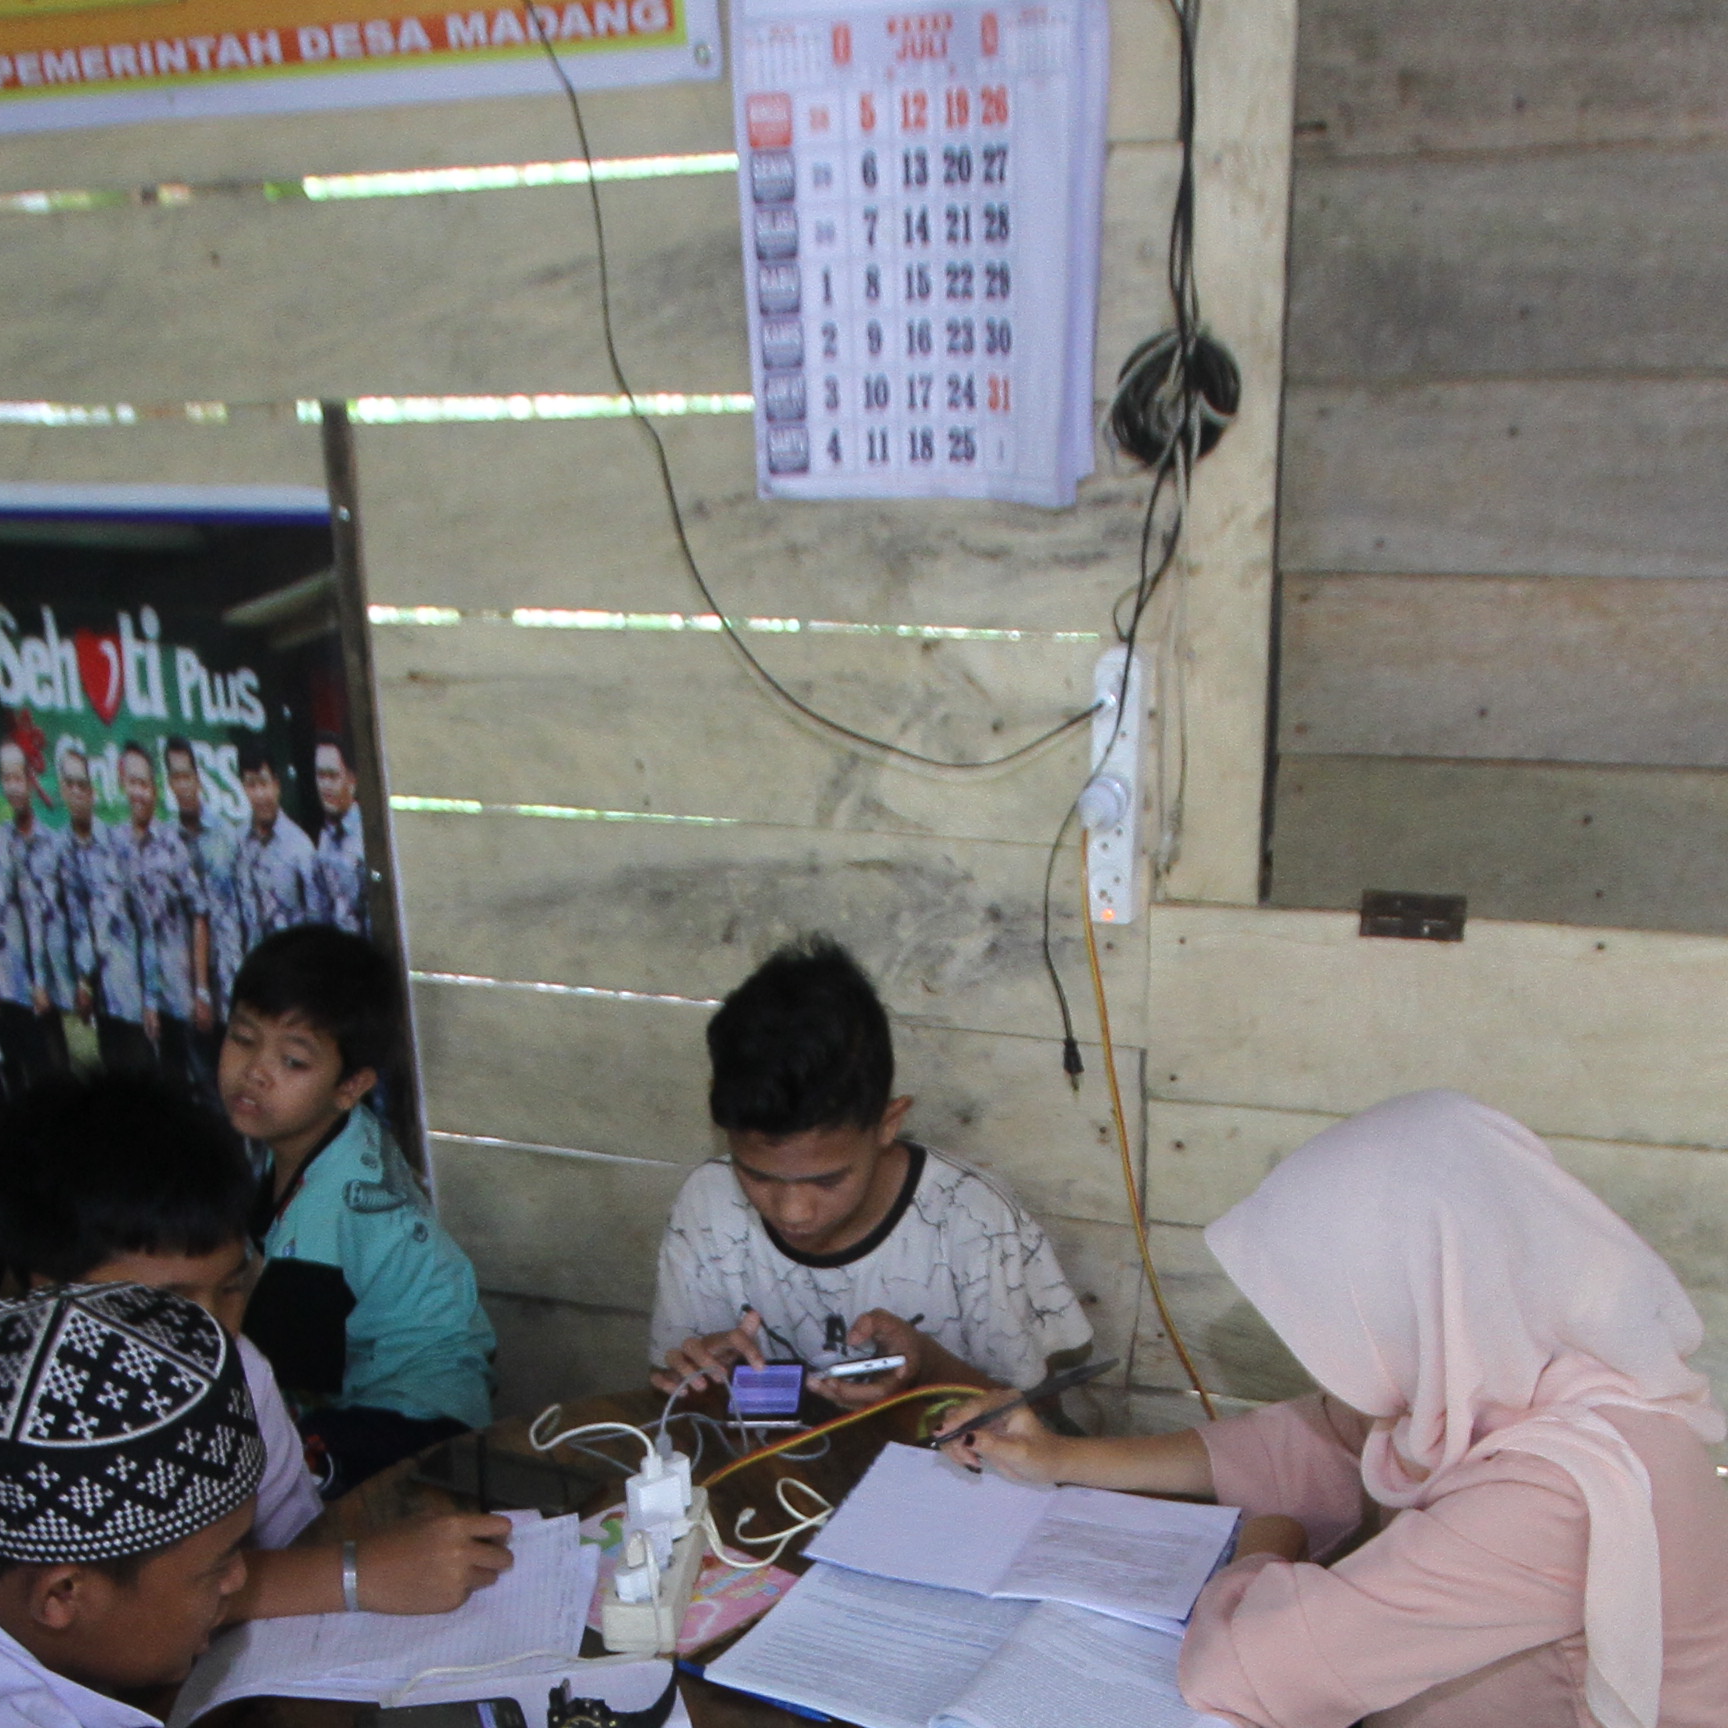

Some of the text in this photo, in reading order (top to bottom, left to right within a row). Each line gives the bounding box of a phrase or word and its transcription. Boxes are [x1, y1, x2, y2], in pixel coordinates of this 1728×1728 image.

[296, 16, 434, 62] DESA
[442, 0, 670, 52] MADANG
[901, 90, 928, 132] 12
[980, 87, 1009, 126] 26
[861, 153, 878, 190] 6
[902, 150, 929, 190] 13
[942, 149, 973, 187] 20
[982, 146, 1008, 185] 27
[863, 209, 878, 248] 7
[904, 209, 930, 246] 14
[945, 207, 972, 245] 21
[983, 206, 1010, 243] 28
[822, 269, 833, 307] 1
[865, 267, 881, 304] 8
[905, 265, 932, 303] 15
[945, 263, 974, 301] 22
[984, 263, 1011, 300] 29
[821, 322, 838, 361] 2
[866, 322, 883, 358] 9
[906, 322, 933, 357] 16
[945, 320, 975, 357] 23
[985, 320, 1012, 357] 30
[824, 376, 841, 414] 3
[864, 377, 890, 411] 10
[907, 375, 933, 412] 17
[947, 375, 976, 411] 24
[987, 376, 1011, 413] 31
[826, 431, 842, 465] 4
[867, 429, 890, 465] 11
[909, 430, 934, 463] 18
[947, 429, 977, 464] 25
